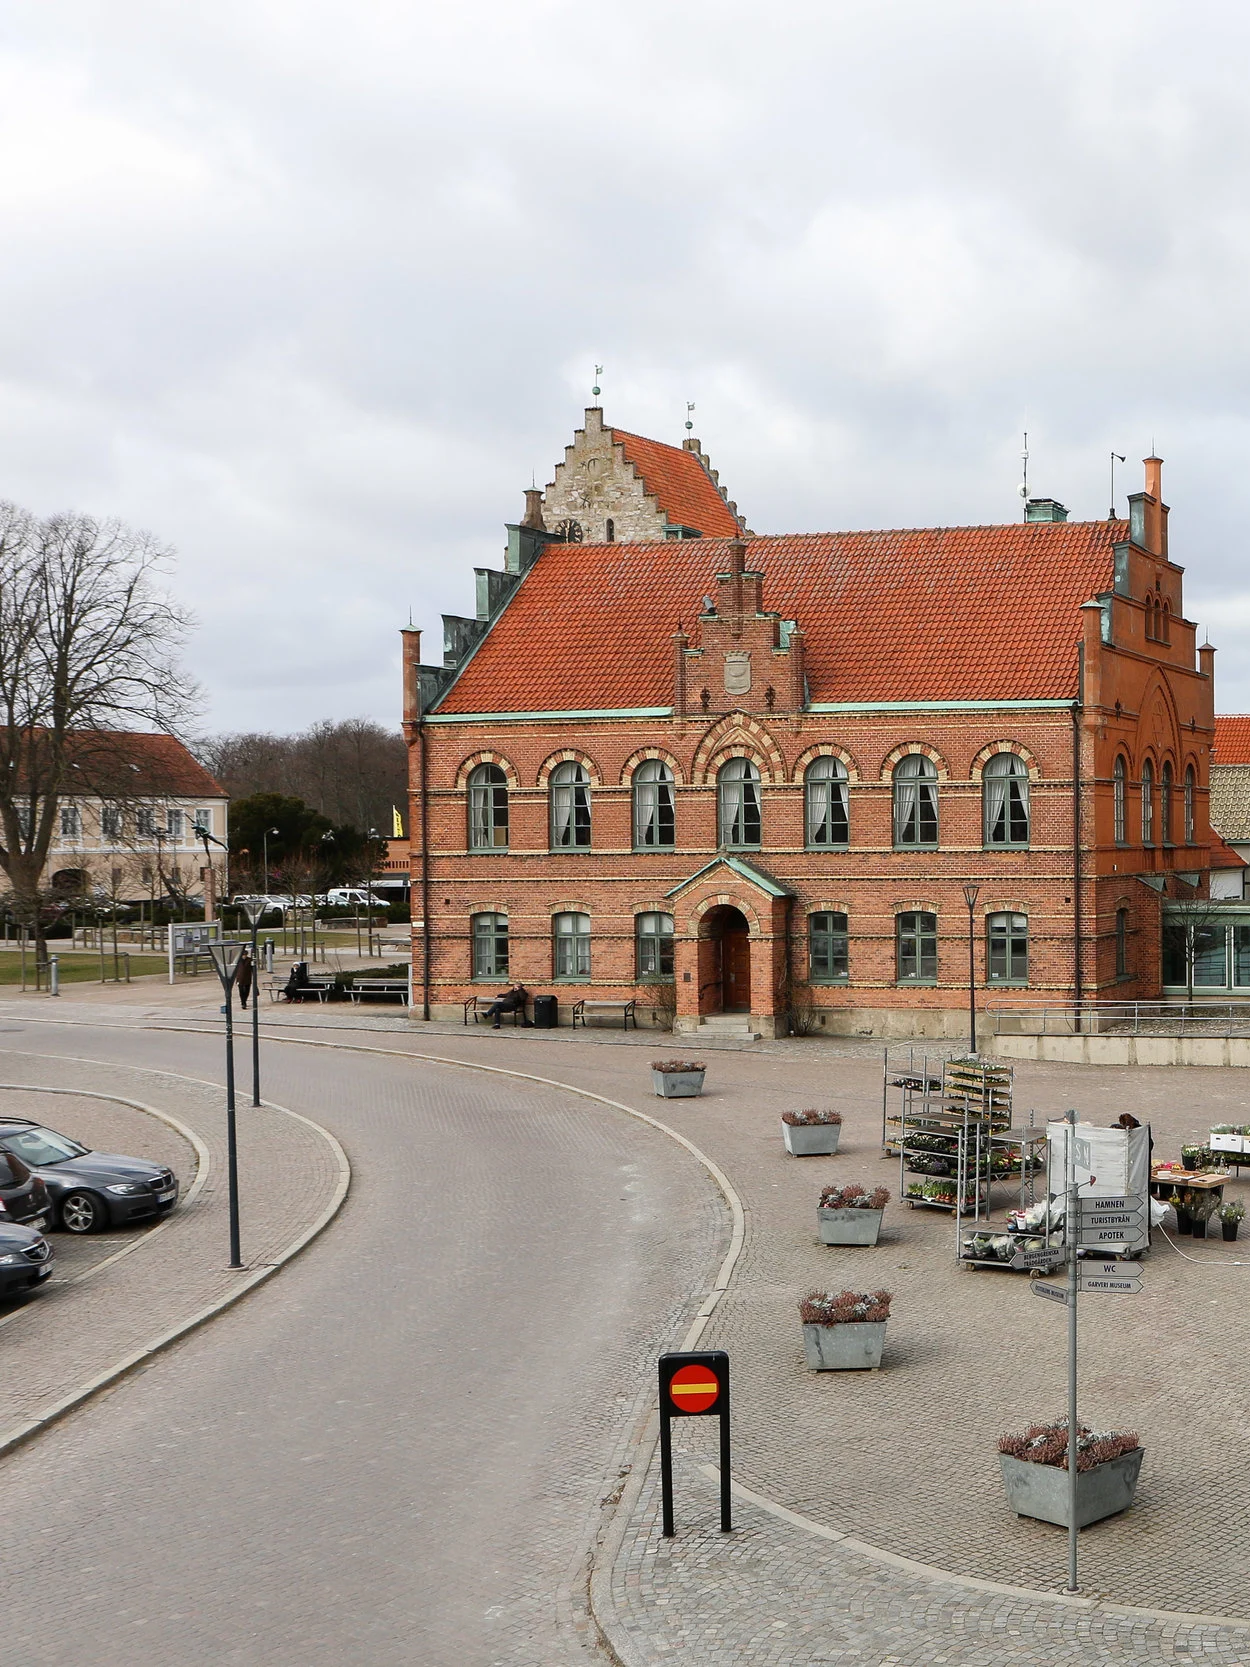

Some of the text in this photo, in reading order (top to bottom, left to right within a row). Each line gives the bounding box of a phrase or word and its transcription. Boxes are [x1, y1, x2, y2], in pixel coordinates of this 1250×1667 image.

[1095, 1200, 1125, 1209] HAMNEN
[1091, 1214, 1131, 1224] TURISTBYRÅN
[1098, 1231, 1125, 1240] APOTEK
[1103, 1265, 1116, 1273] WC
